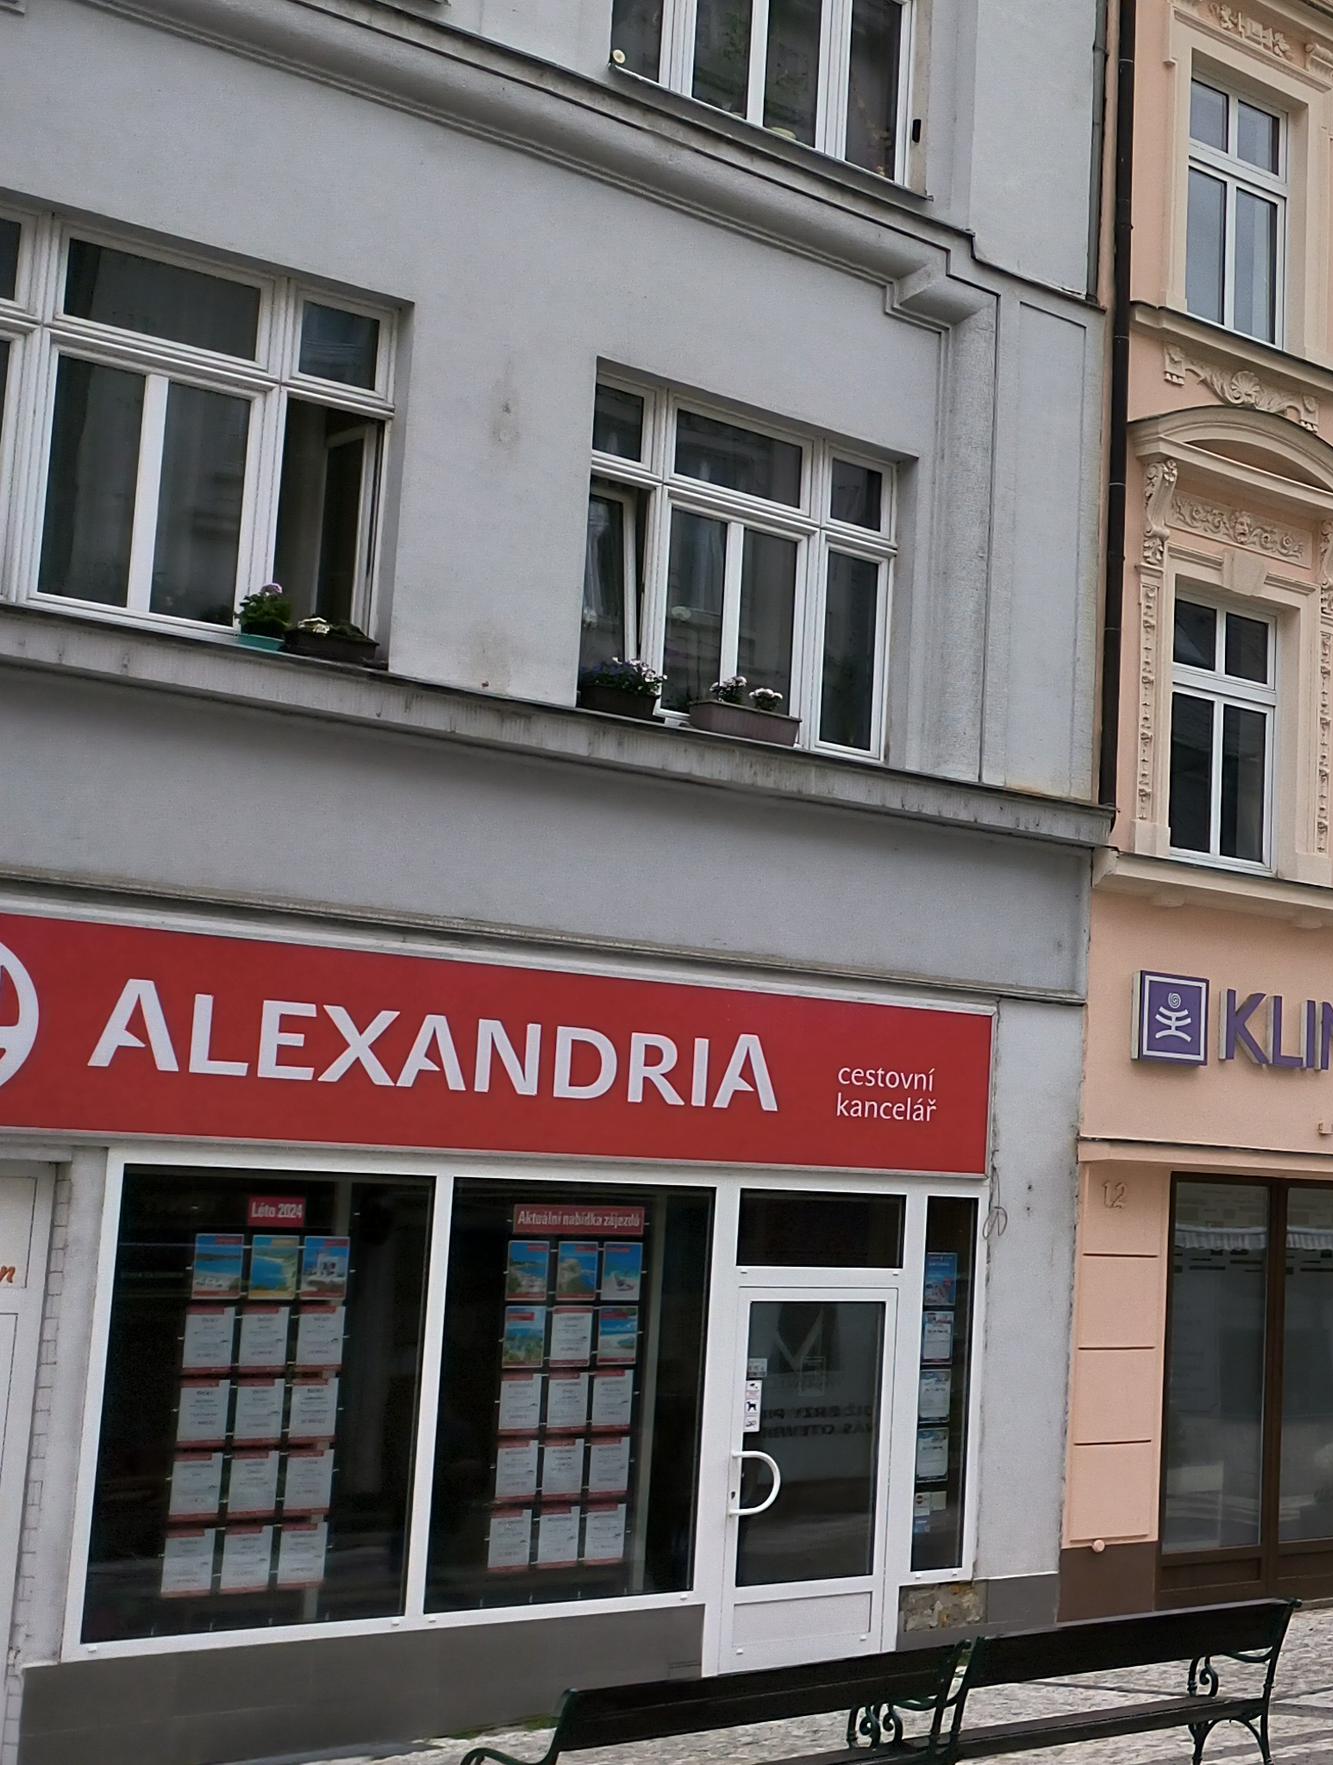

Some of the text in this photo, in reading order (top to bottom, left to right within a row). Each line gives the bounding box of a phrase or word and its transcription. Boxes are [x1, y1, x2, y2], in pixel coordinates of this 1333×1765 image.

[87, 979, 778, 1112] ALEXANDRIA
[838, 1066, 935, 1092] cestovní
[836, 1093, 936, 1122] kancelář
[1102, 1180, 1128, 1210] 12
[251, 1201, 303, 1218] Léto 2024
[517, 1210, 562, 1225] Aktuální
